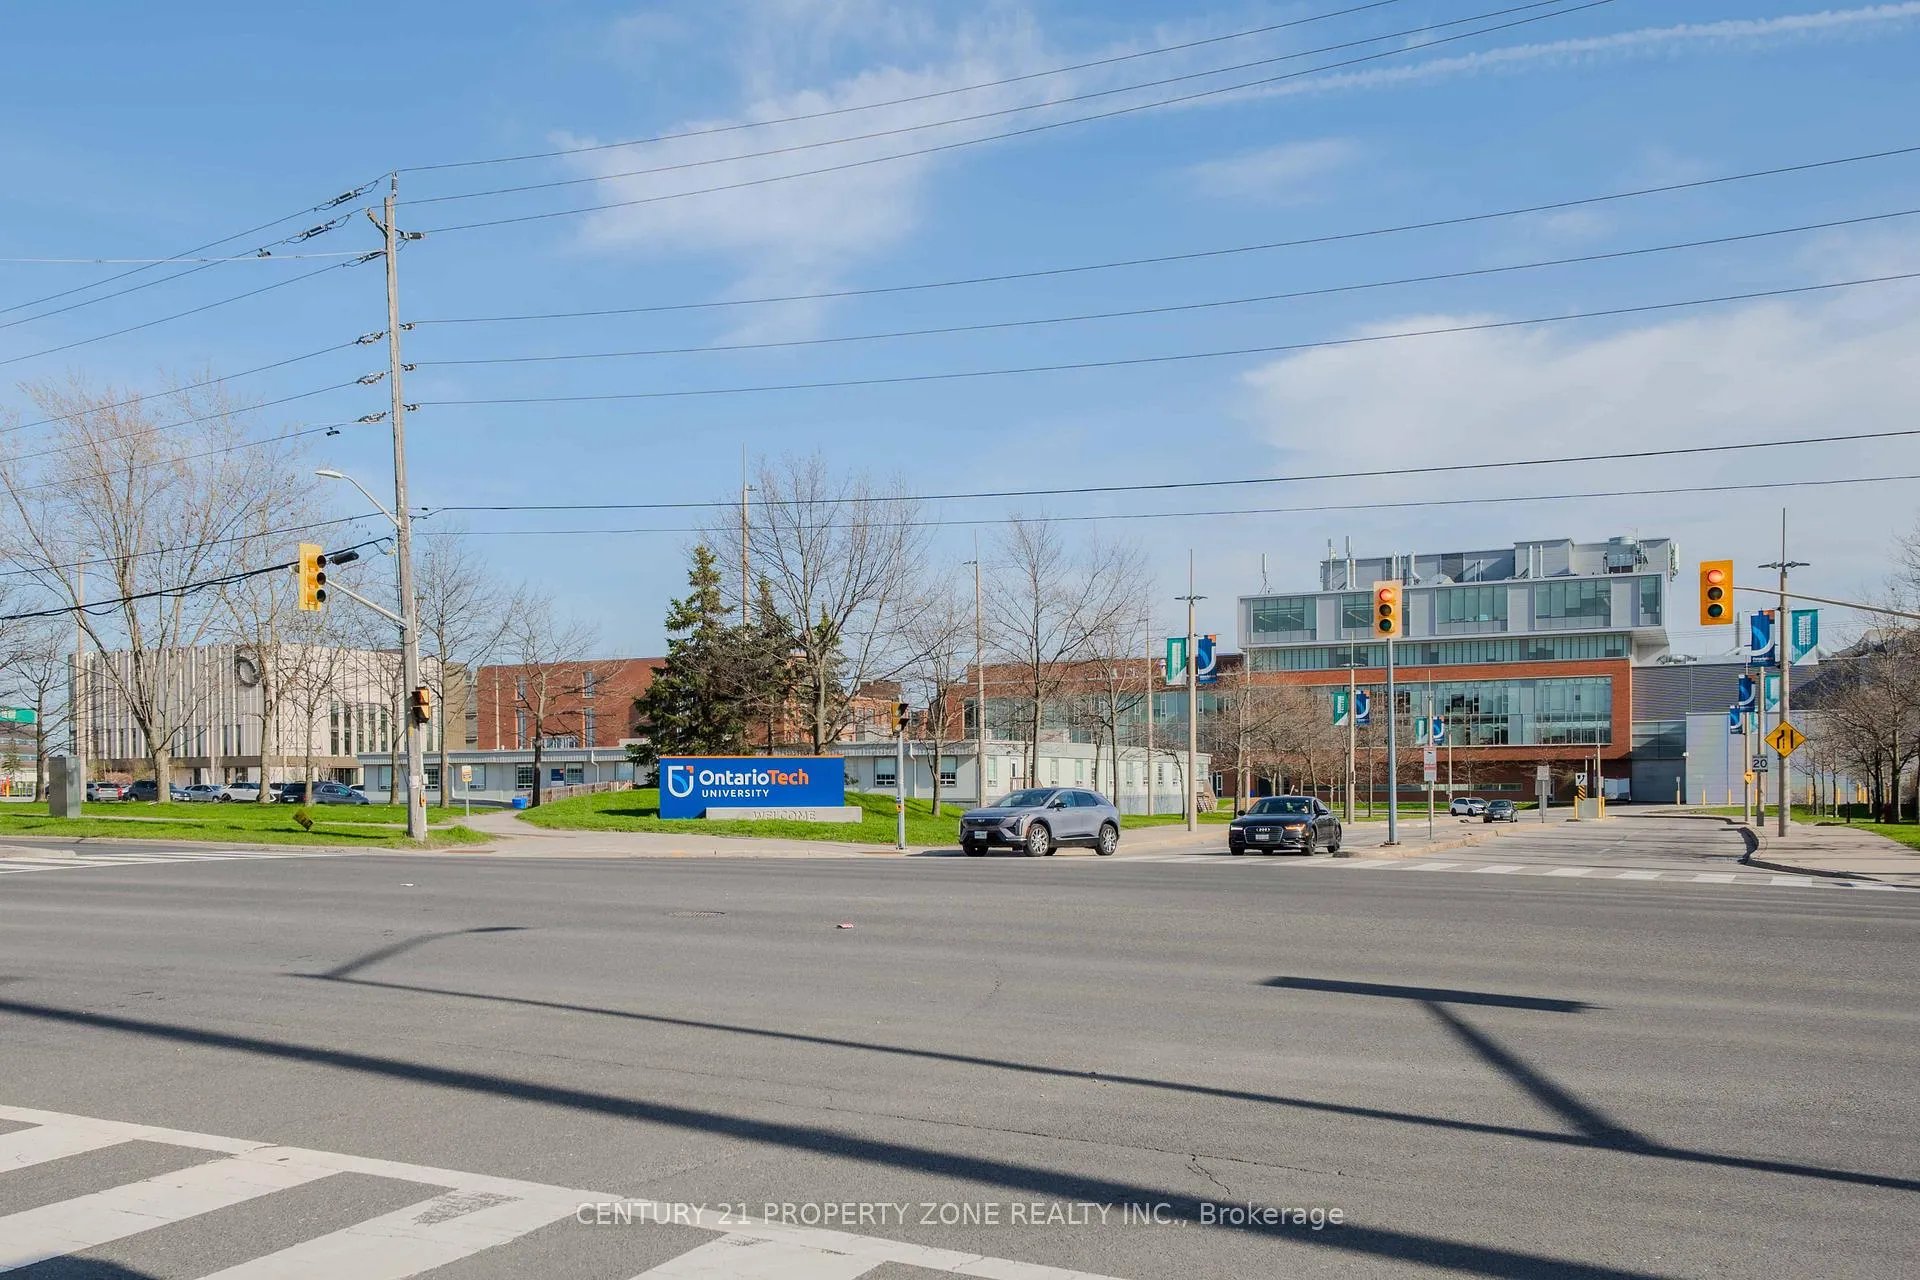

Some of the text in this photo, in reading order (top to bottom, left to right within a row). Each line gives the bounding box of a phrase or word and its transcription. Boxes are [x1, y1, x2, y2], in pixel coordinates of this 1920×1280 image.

[1753, 760, 1767, 768] 20
[699, 769, 809, 785] OntarioTech
[702, 789, 769, 798] UNIVERSITY
[753, 810, 816, 820] WELCOME
